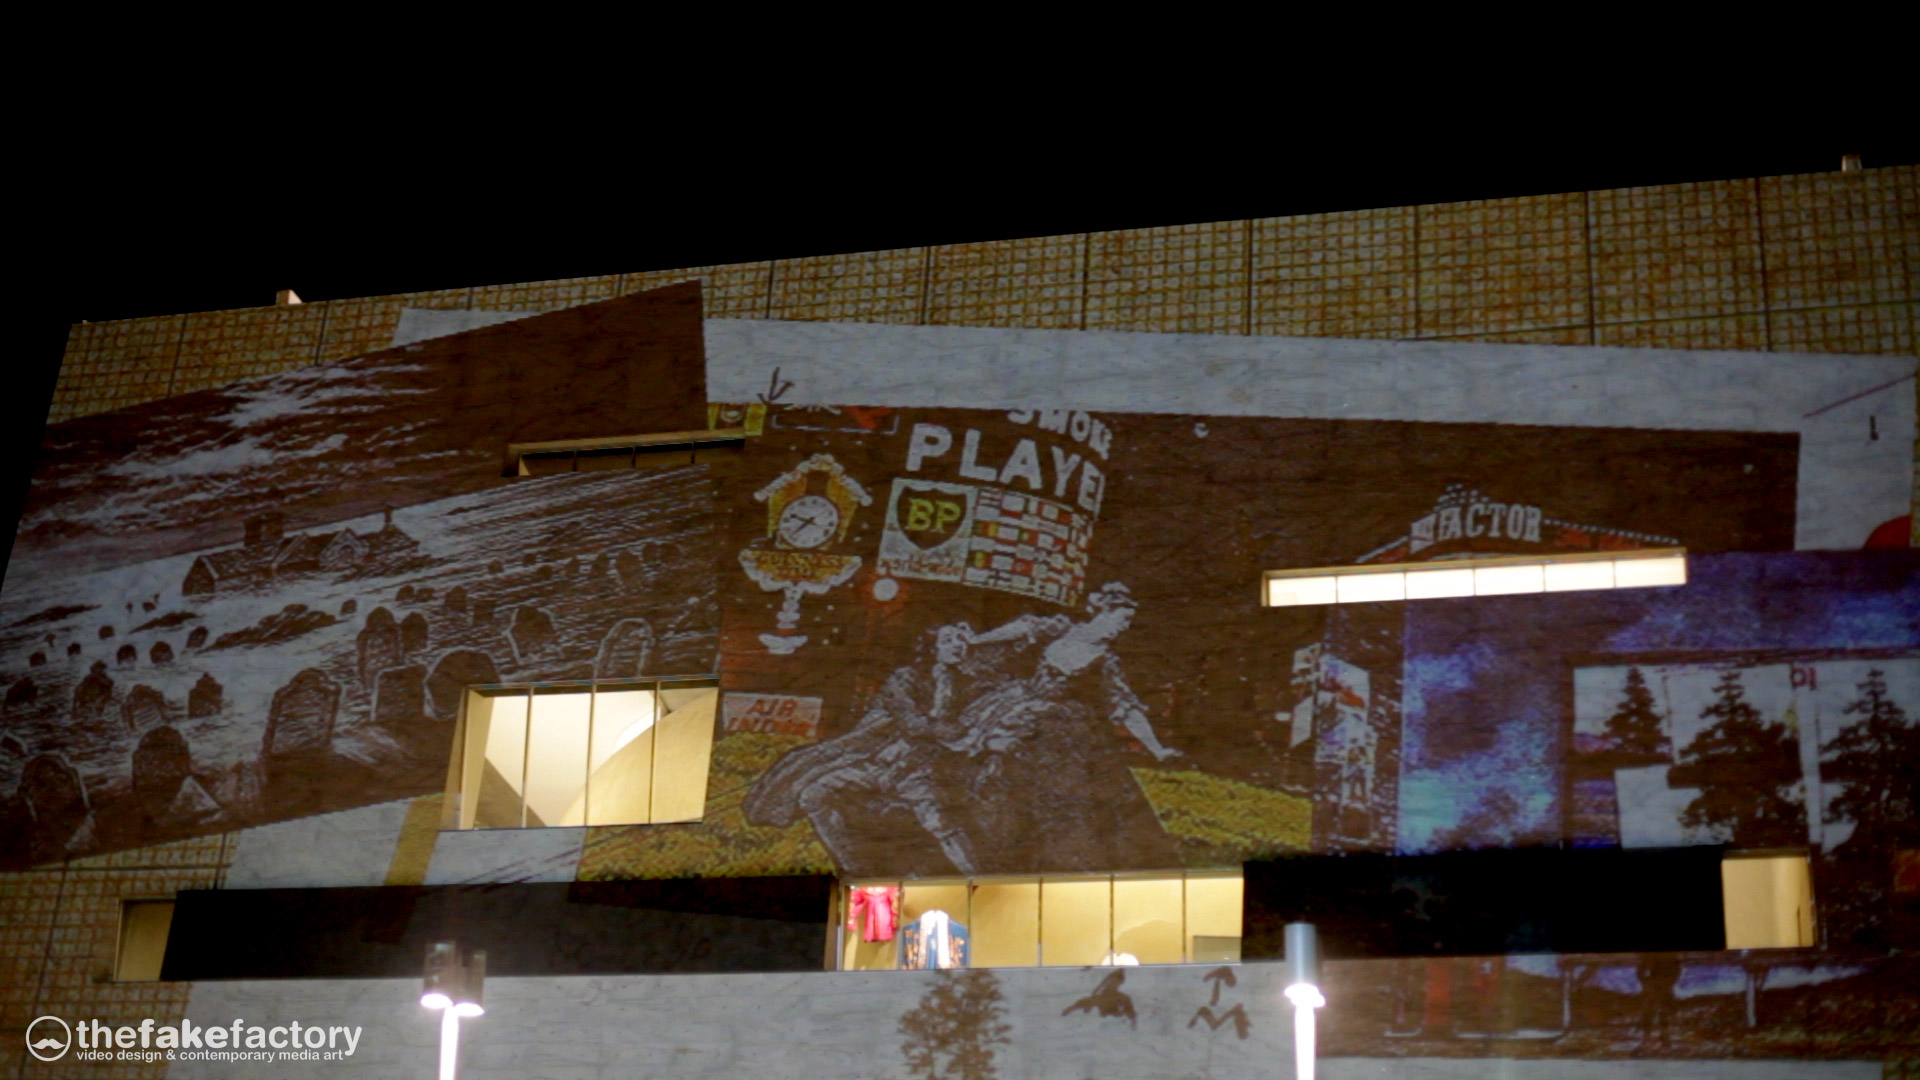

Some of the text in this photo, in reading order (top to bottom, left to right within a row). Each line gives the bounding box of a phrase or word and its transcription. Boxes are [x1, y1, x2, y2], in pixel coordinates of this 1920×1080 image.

[905, 423, 1105, 520] PLAYE
[906, 496, 962, 534] BP
[1437, 502, 1543, 543] FACTOR
[746, 698, 799, 717] AIR
